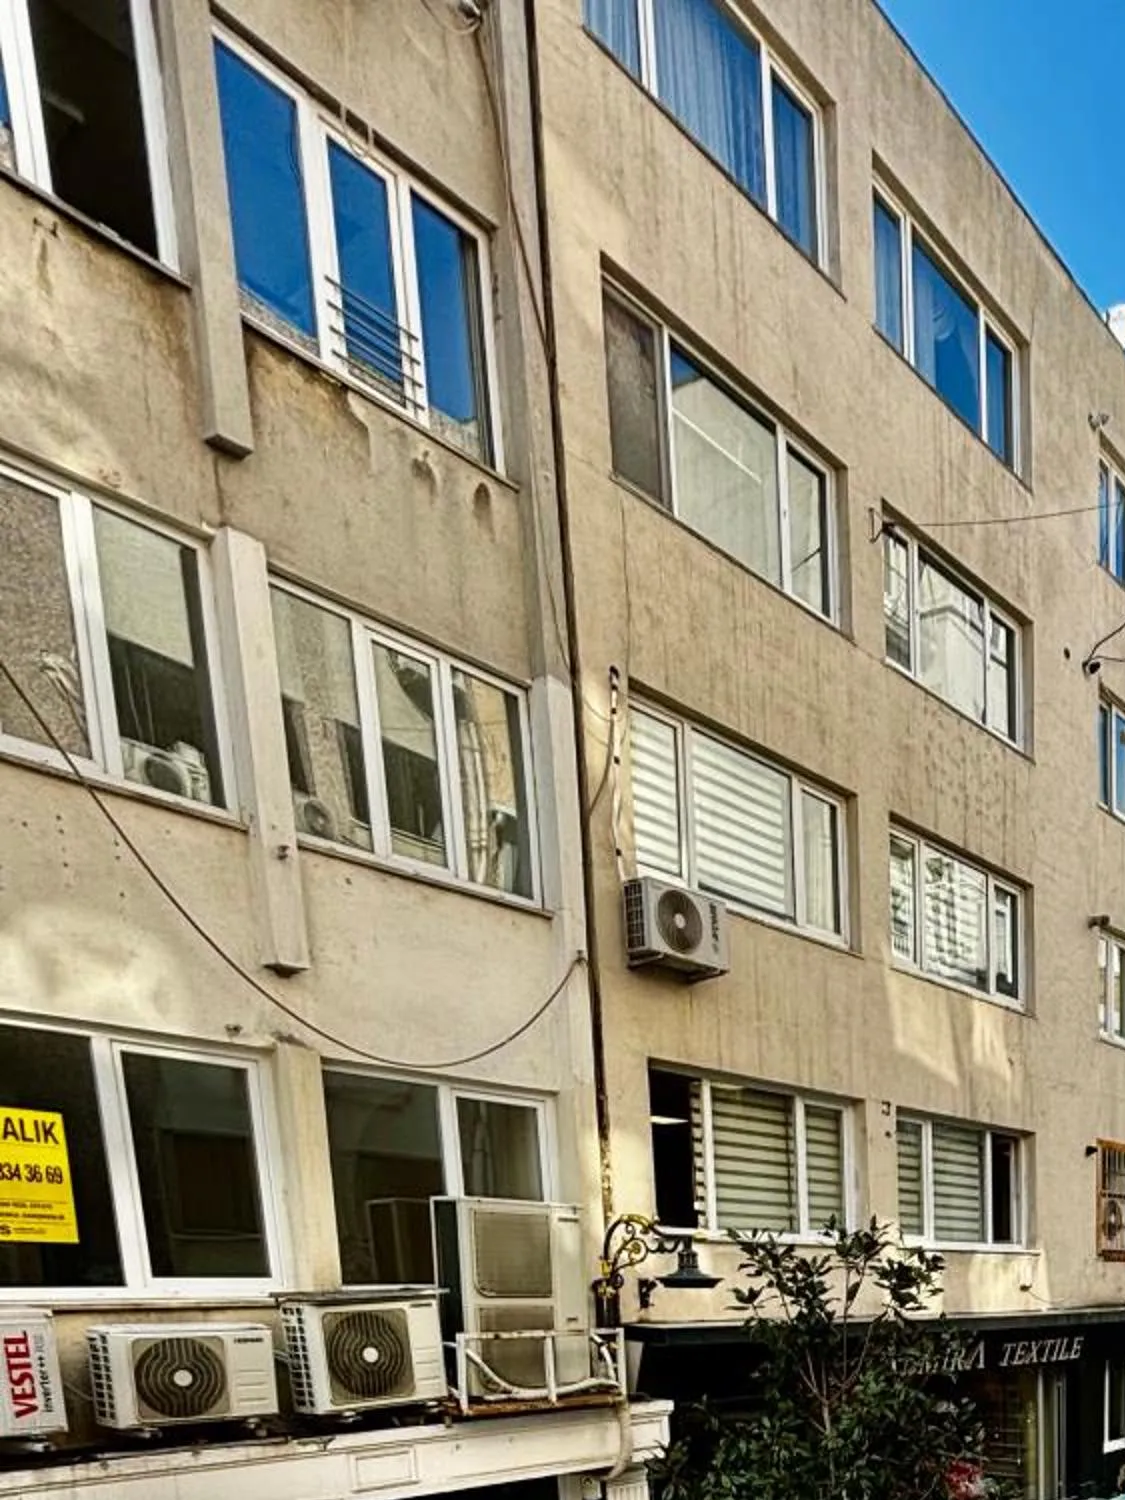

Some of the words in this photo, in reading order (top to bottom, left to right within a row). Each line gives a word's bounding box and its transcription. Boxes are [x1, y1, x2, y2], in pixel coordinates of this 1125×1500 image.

[24, 1164, 43, 1183] 36
[45, 1166, 64, 1185] 69
[998, 1336, 1084, 1368] TEXTILE
[3, 1330, 39, 1418] VESTEL
